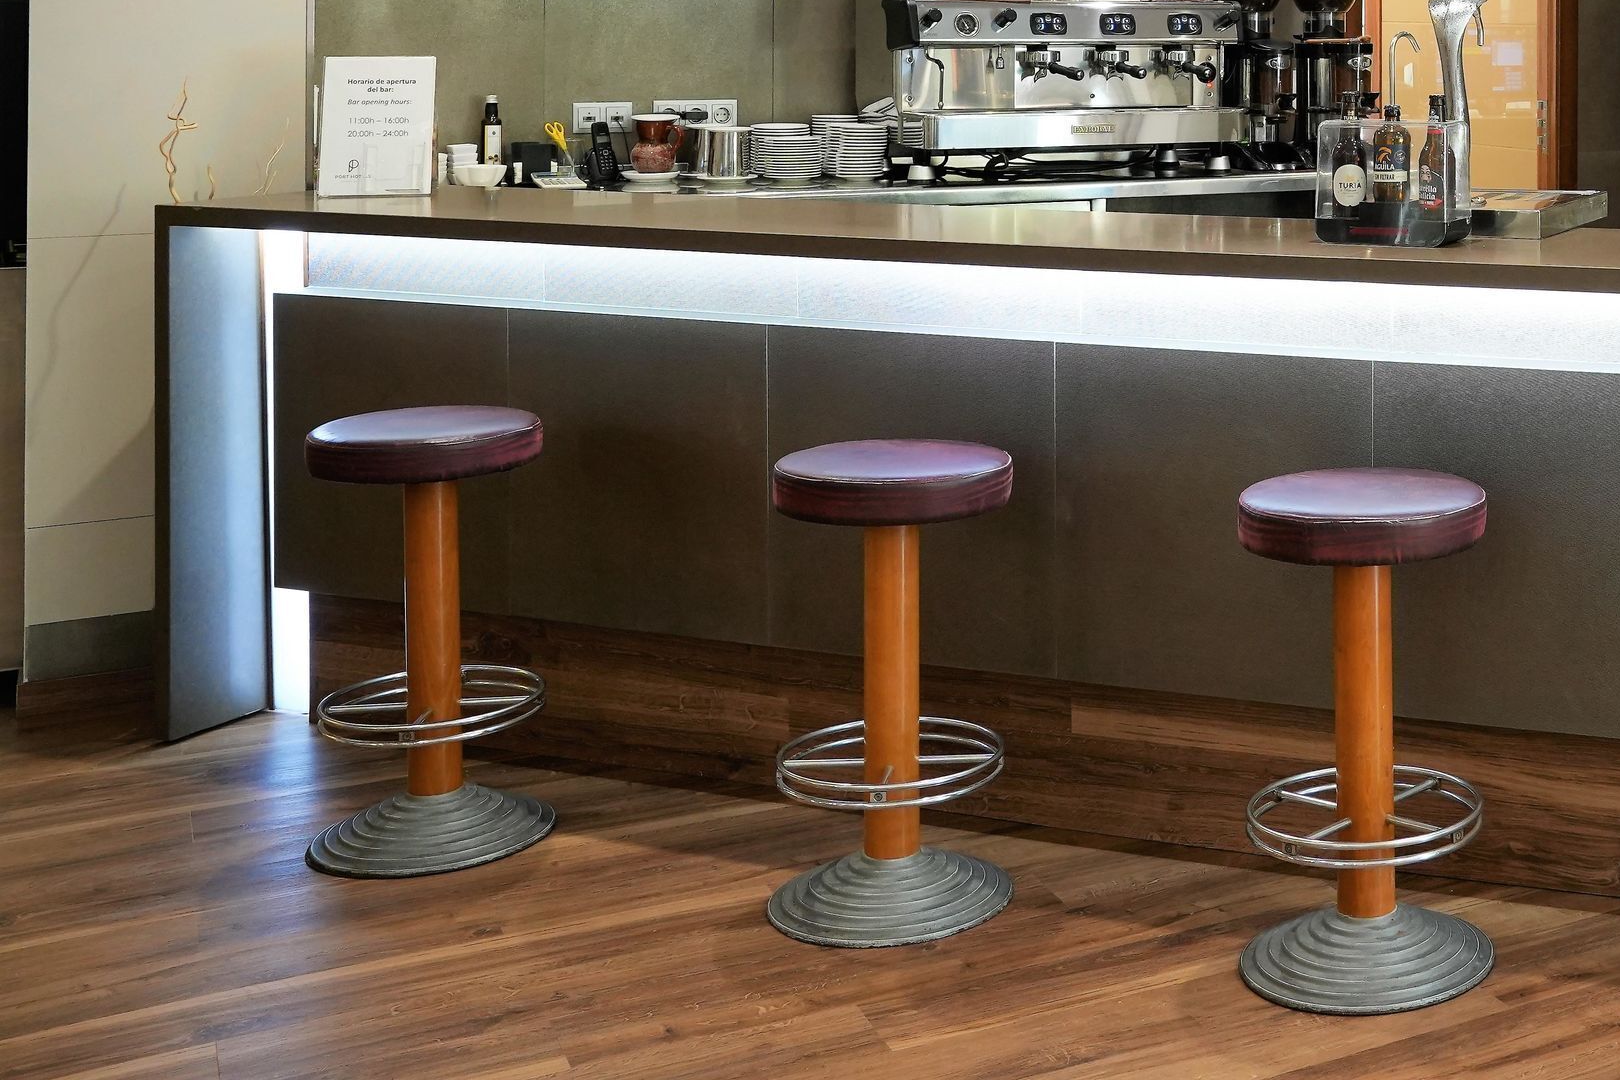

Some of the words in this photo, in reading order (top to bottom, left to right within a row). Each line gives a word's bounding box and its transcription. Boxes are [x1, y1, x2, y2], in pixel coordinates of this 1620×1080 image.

[349, 117, 375, 125] 11:00h
[384, 116, 410, 124] 16:00h
[347, 130, 374, 138] 20:00h
[382, 129, 409, 137] 24:00h
